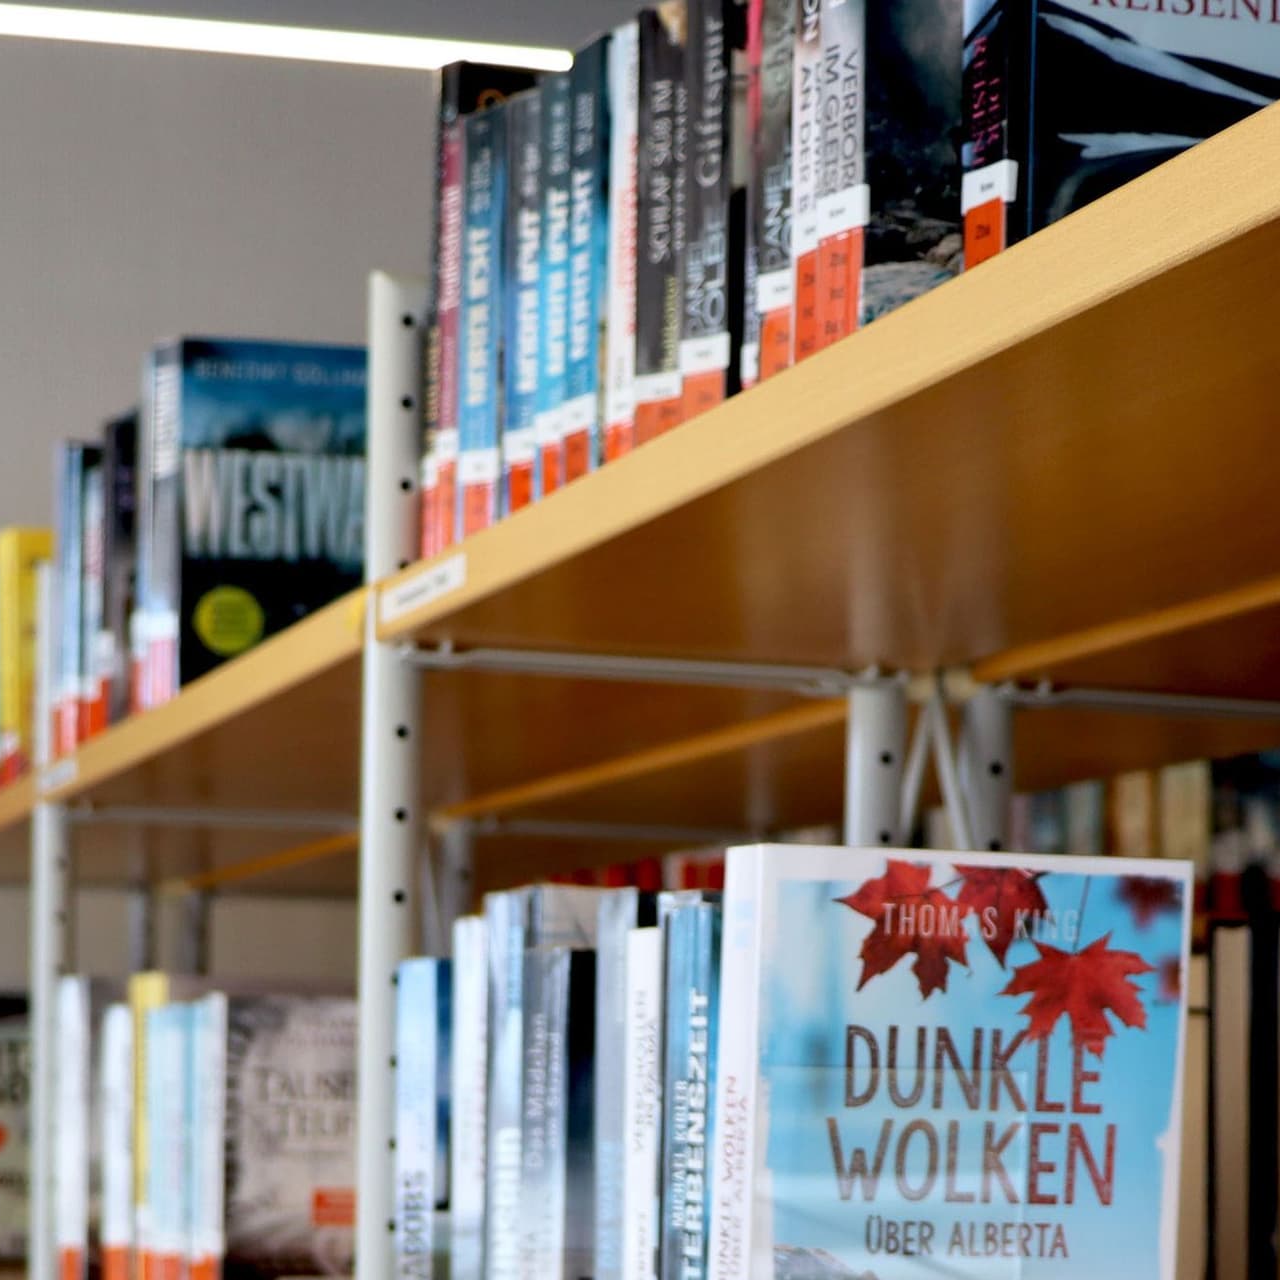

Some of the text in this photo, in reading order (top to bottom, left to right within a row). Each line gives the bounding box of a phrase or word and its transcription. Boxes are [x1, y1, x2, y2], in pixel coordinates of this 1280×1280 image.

[694, 15, 727, 188] Giftspur
[702, 206, 726, 332] OLBE
[883, 902, 1080, 942] THOMAS KING
[844, 1023, 1103, 1114] DUNKLE
[723, 1075, 737, 1184] WOLKEN
[826, 1116, 1117, 1206] WOLKEN
[672, 1148, 686, 1228] MICHAEL
[865, 1214, 1069, 1258] ÜBER ALBERTA
